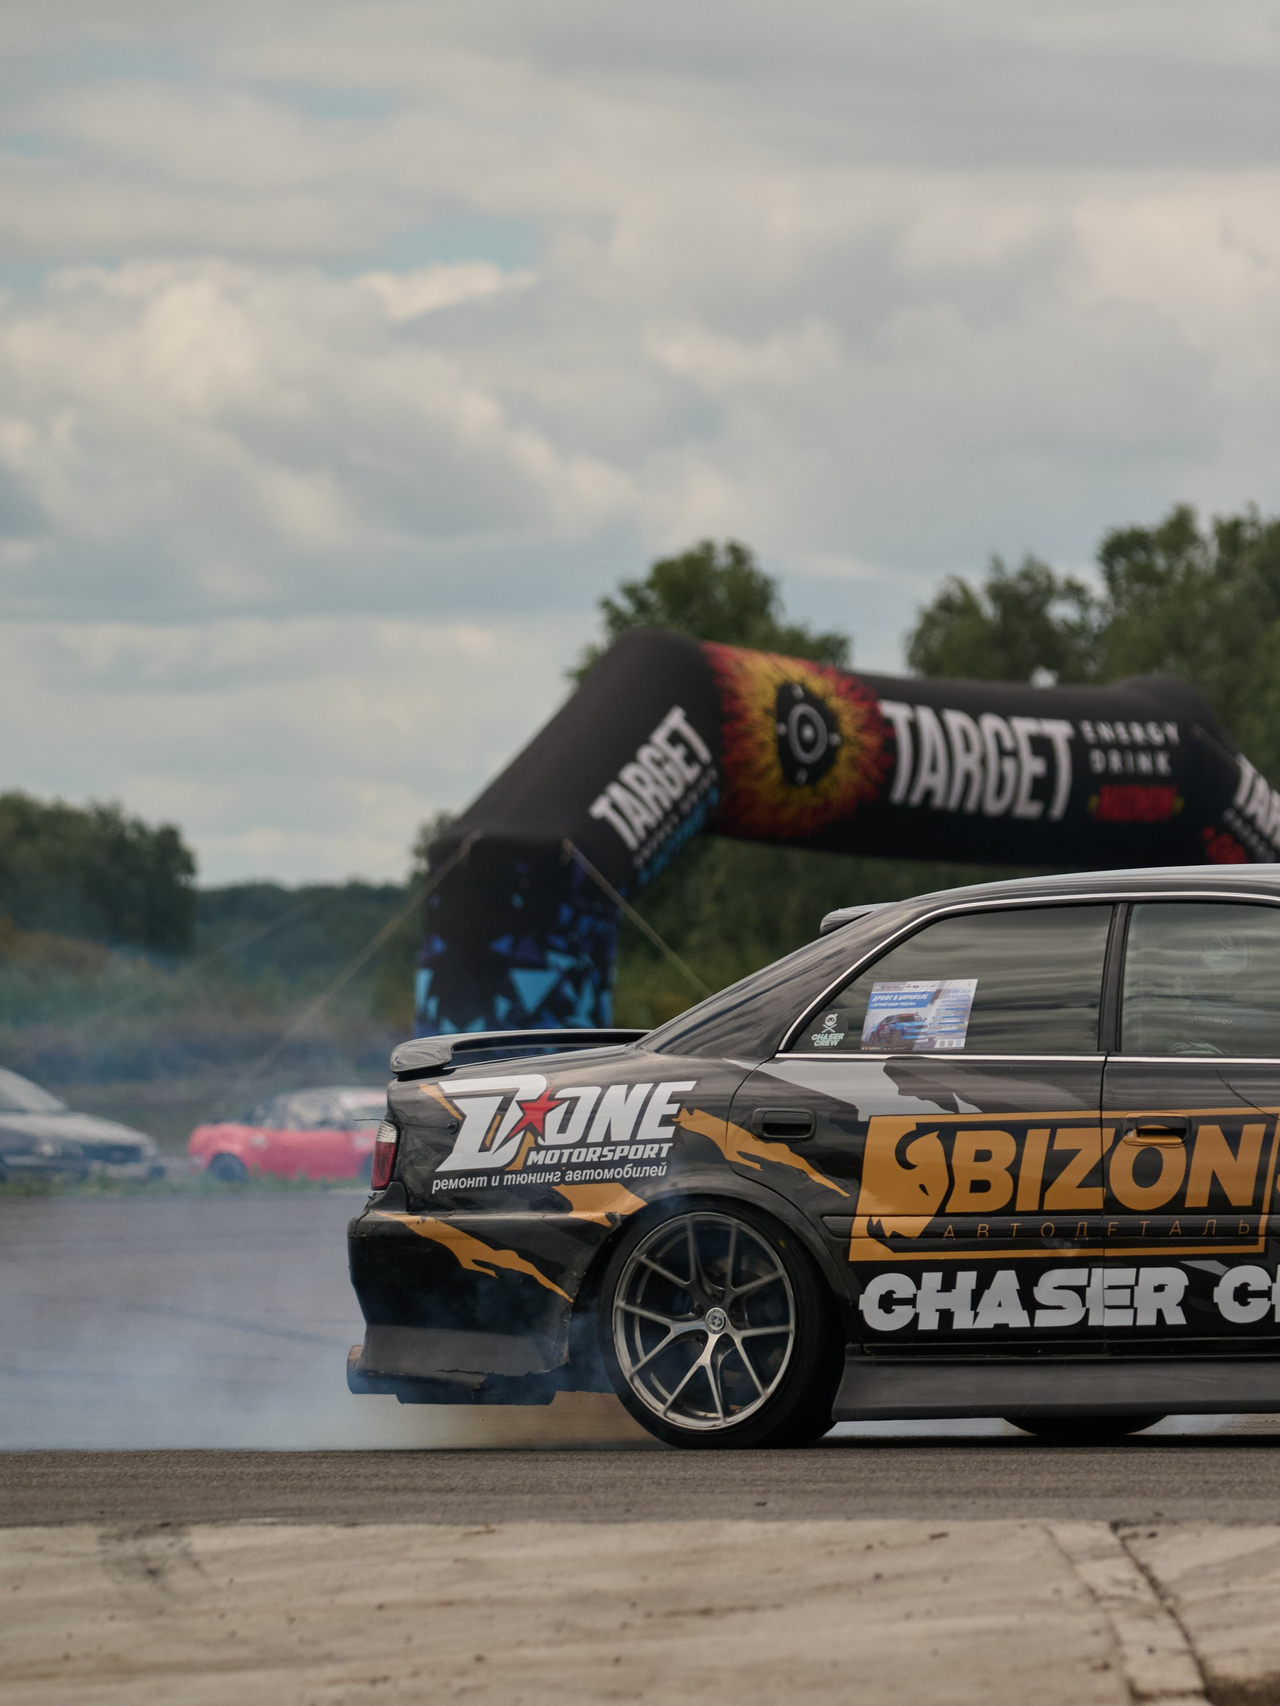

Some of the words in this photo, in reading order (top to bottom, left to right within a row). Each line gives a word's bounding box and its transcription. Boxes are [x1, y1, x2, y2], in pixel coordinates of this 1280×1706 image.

[1079, 719, 1180, 746] ENERGY
[881, 700, 1074, 822] TARGET
[1089, 748, 1172, 777] DRINK
[588, 704, 713, 851] TARGET
[811, 1033, 845, 1041] CHASER
[814, 1039, 841, 1047] CREW
[526, 1143, 673, 1166] MOTORSPORT
[946, 1122, 1268, 1213] BIZON
[431, 1174, 488, 1194] ремонт
[490, 1174, 500, 1187] и
[503, 1170, 562, 1185] тюнинг
[565, 1162, 668, 1182] автомобилей
[859, 1266, 1190, 1332] CHASER
